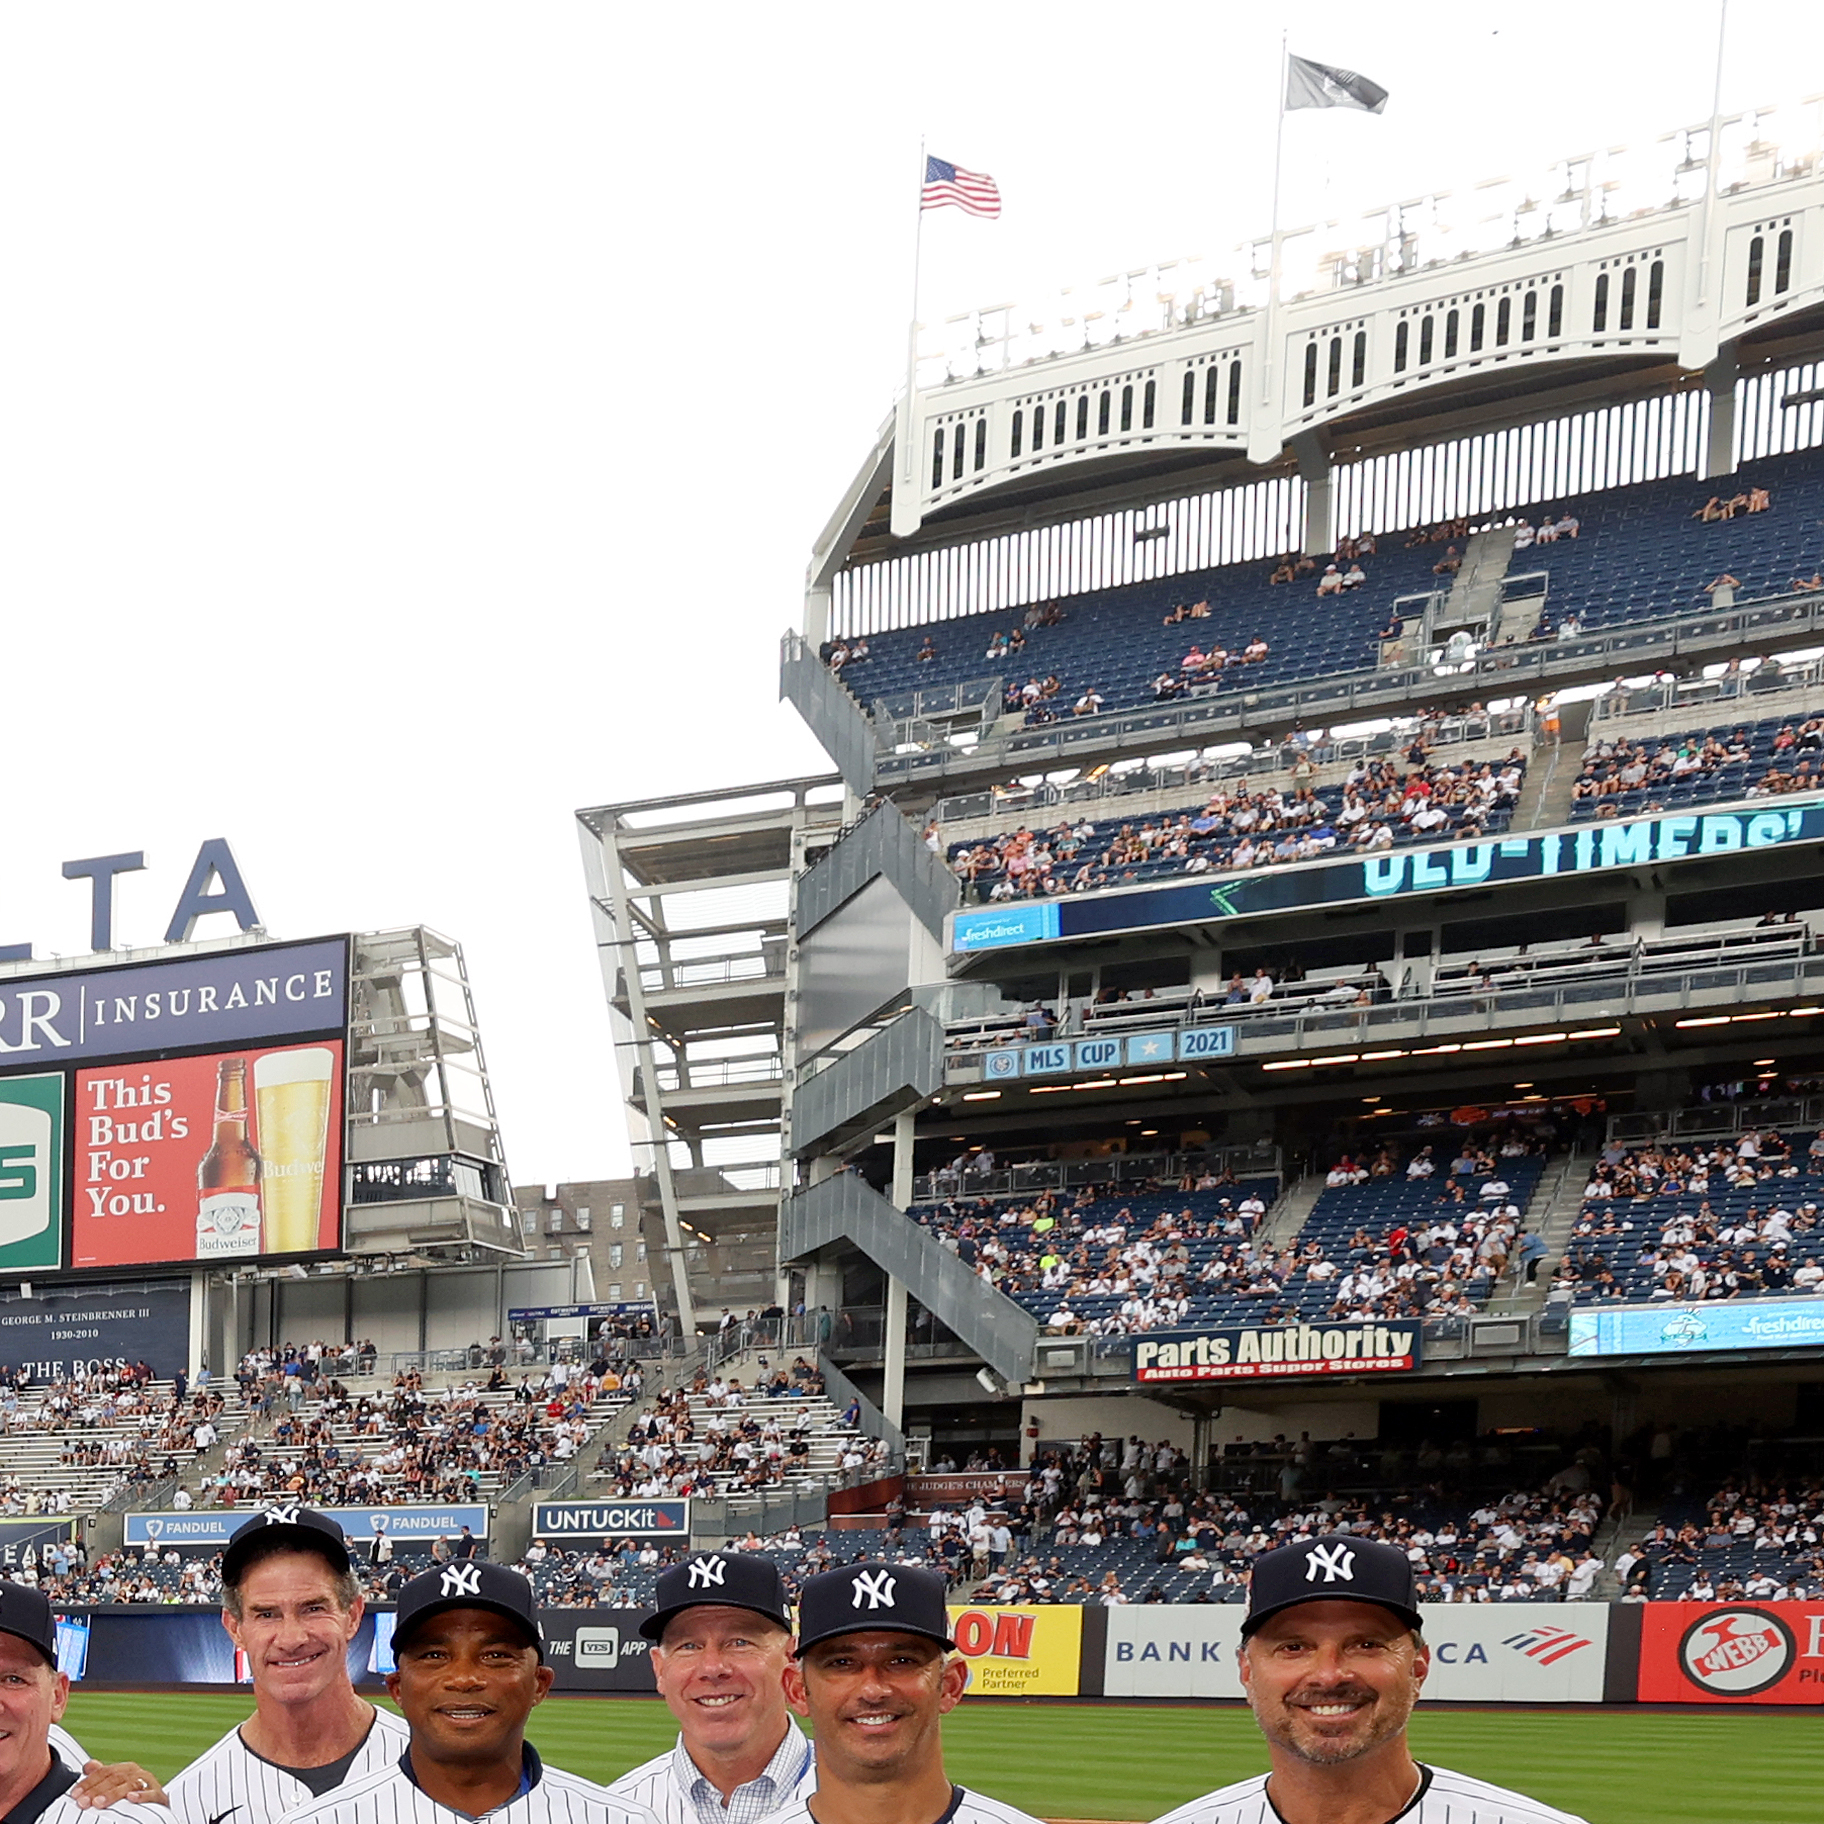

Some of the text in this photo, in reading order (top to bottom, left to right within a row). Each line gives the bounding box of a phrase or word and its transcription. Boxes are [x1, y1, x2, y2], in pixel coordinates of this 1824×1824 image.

[967, 922, 1025, 941] freshdirect
[94, 969, 333, 1026] INSURANCE
[1030, 1030, 1228, 1070] MLS CUP 2021
[87, 1074, 172, 1110] This
[87, 1110, 189, 1147] Bud's
[87, 1150, 151, 1183] For
[86, 1186, 166, 1217] You.
[199, 1236, 257, 1252] Budweiser
[2, 1309, 135, 1326] GEORGE M. STEINBRENNER
[51, 1329, 99, 1340] 1930-2010
[1136, 1324, 1413, 1368] Parts Authority
[22, 1360, 64, 1378] THE
[1144, 1358, 1404, 1379] Auto Parts Super Stores
[919, 1478, 1027, 1491] JUDGE'S CHAMERS
[166, 1515, 459, 1534] FANDUEL FANDUEL
[264, 1505, 300, 1525] NY
[546, 1508, 656, 1530] UNTUCKit
[688, 1554, 727, 1589] NY
[1306, 1544, 1355, 1581] NY
[441, 1563, 481, 1596] NY
[852, 1570, 896, 1608] NY
[549, 1640, 648, 1657] THE YES APP
[1115, 1641, 1221, 1663] BANK
[1704, 1635, 1770, 1670] WEBB
[982, 1668, 1039, 1679] Preferred
[982, 1679, 1027, 1690] Partner
